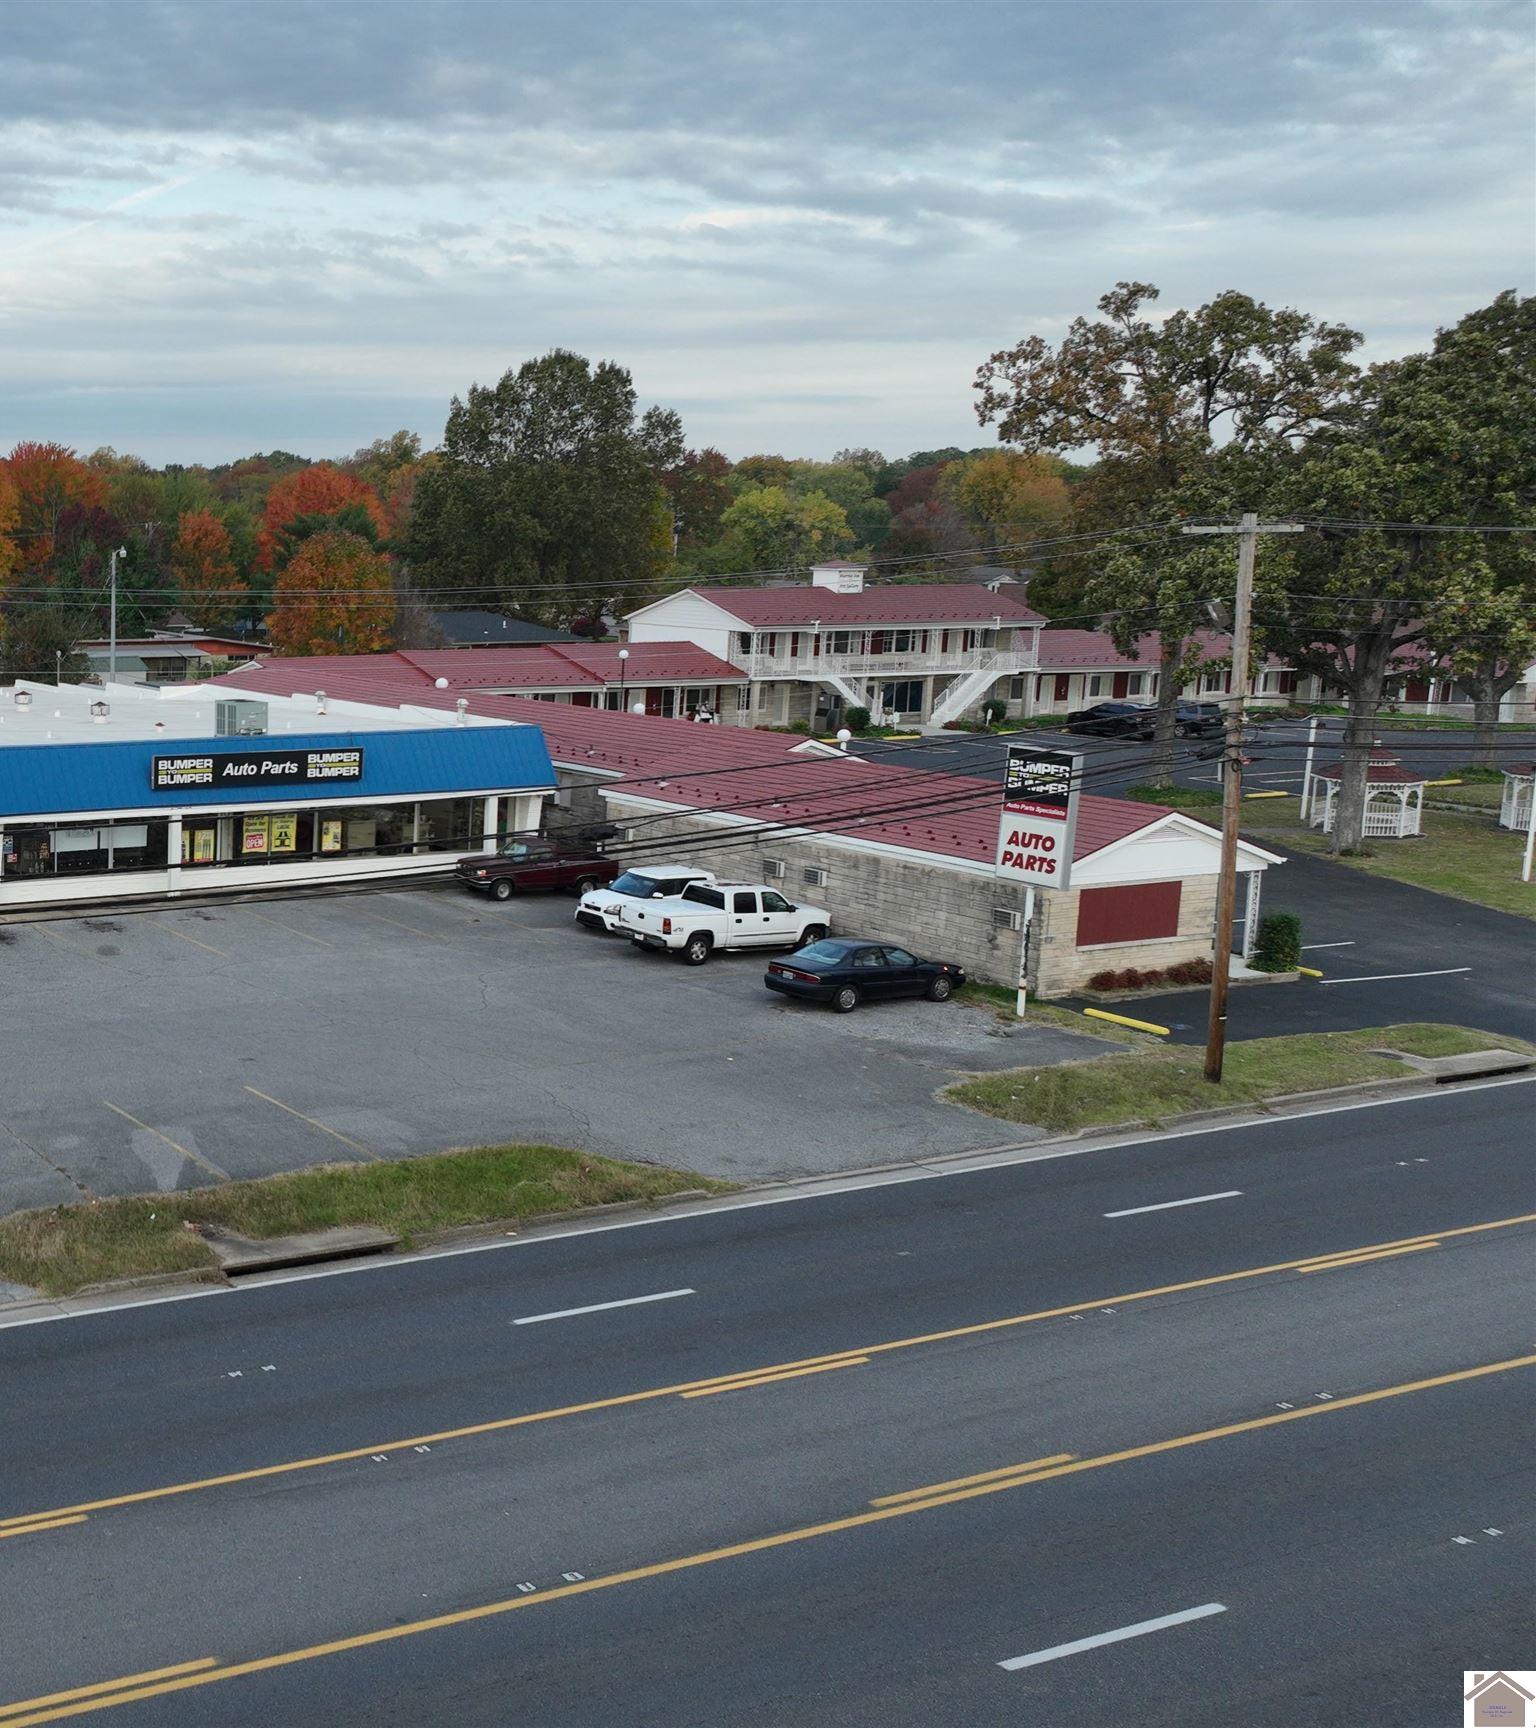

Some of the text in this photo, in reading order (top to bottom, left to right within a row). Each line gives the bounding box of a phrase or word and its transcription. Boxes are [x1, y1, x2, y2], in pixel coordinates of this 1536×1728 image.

[306, 752, 360, 763] BUMPER
[158, 759, 213, 770] BUMPER
[222, 760, 299, 776] Auto Parts
[1009, 759, 1071, 778] BUMPER
[307, 767, 359, 778] BUMPER
[158, 773, 213, 785] BUMPER
[1020, 804, 1035, 812] Parts
[246, 839, 264, 849] OPEN
[1007, 830, 1056, 852] AUTO
[1001, 850, 1057, 875] PARTS
